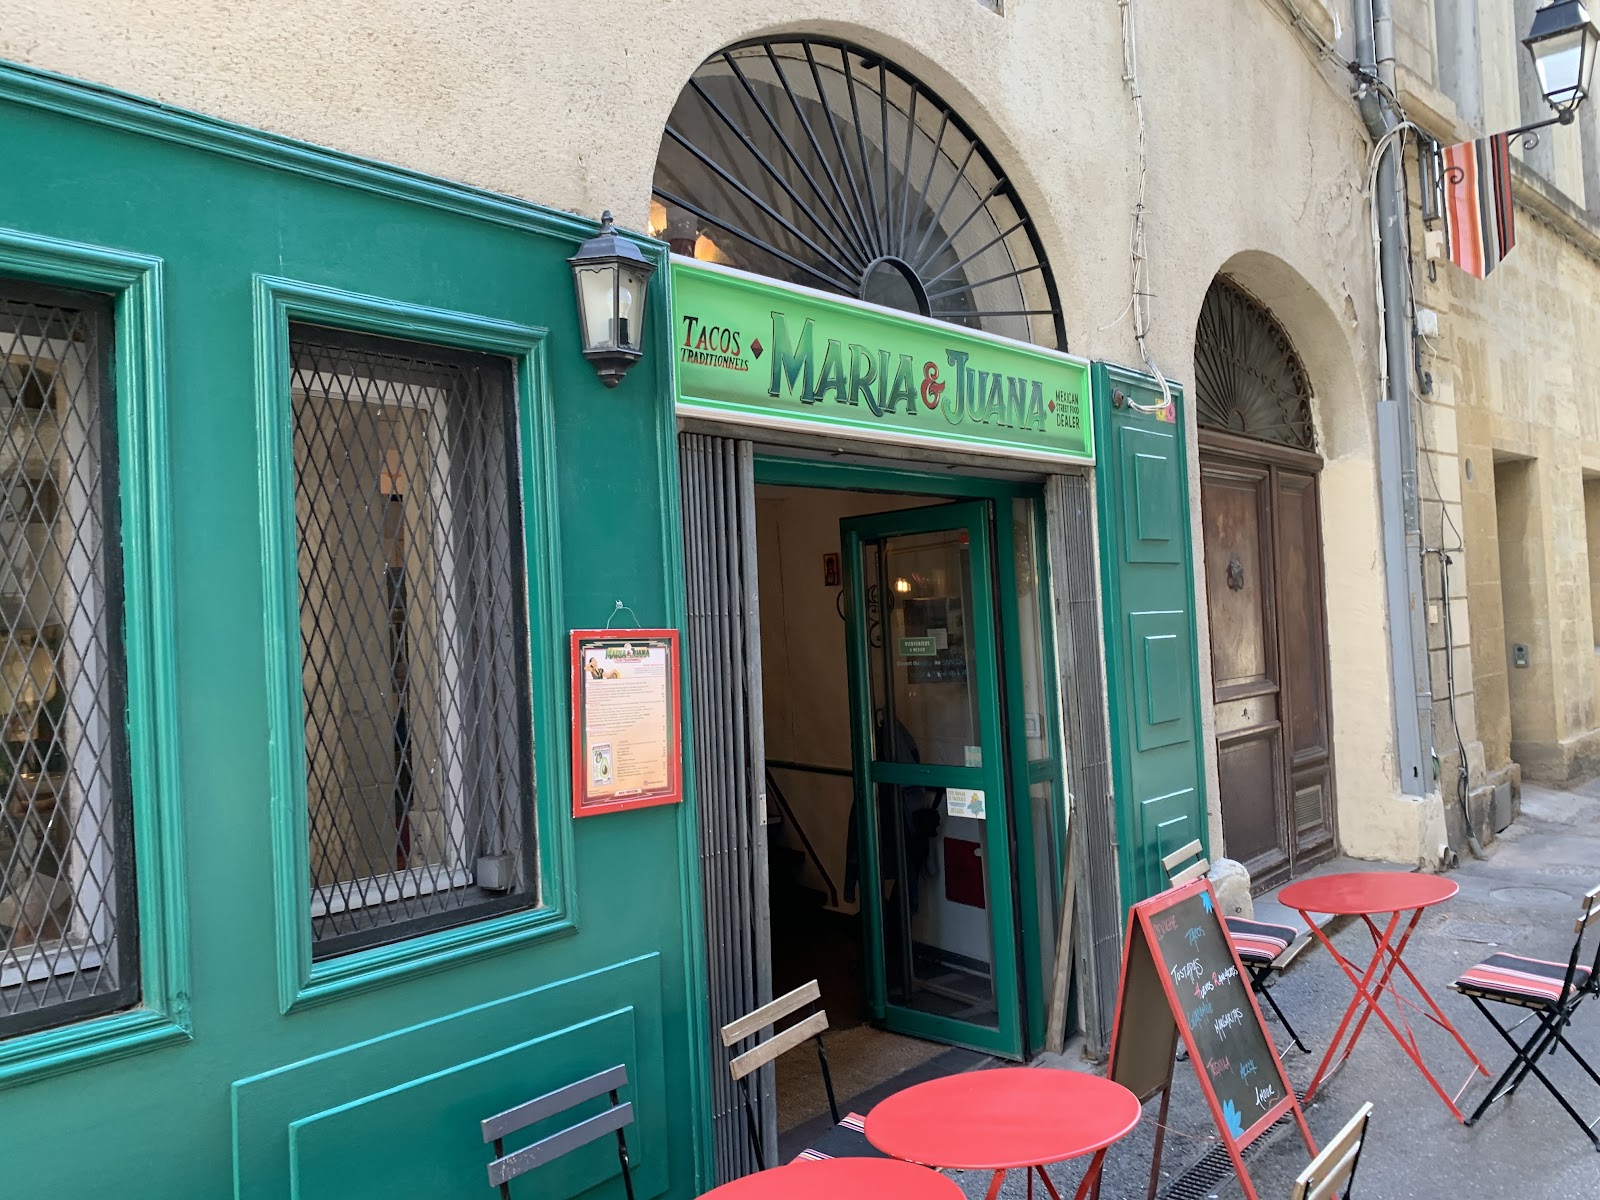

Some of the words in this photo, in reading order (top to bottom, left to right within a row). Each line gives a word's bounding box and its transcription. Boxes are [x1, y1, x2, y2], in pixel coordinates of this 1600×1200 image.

[682, 315, 741, 357] TACOS
[680, 347, 749, 372] TRADITIONNELS
[767, 311, 918, 417] MARIA
[920, 361, 946, 410] &
[941, 348, 1047, 432] JUANA
[1055, 389, 1079, 406] MEXICAN
[1056, 402, 1070, 413] STREET
[1069, 405, 1080, 415] FOOD
[1056, 412, 1081, 430] DEALER
